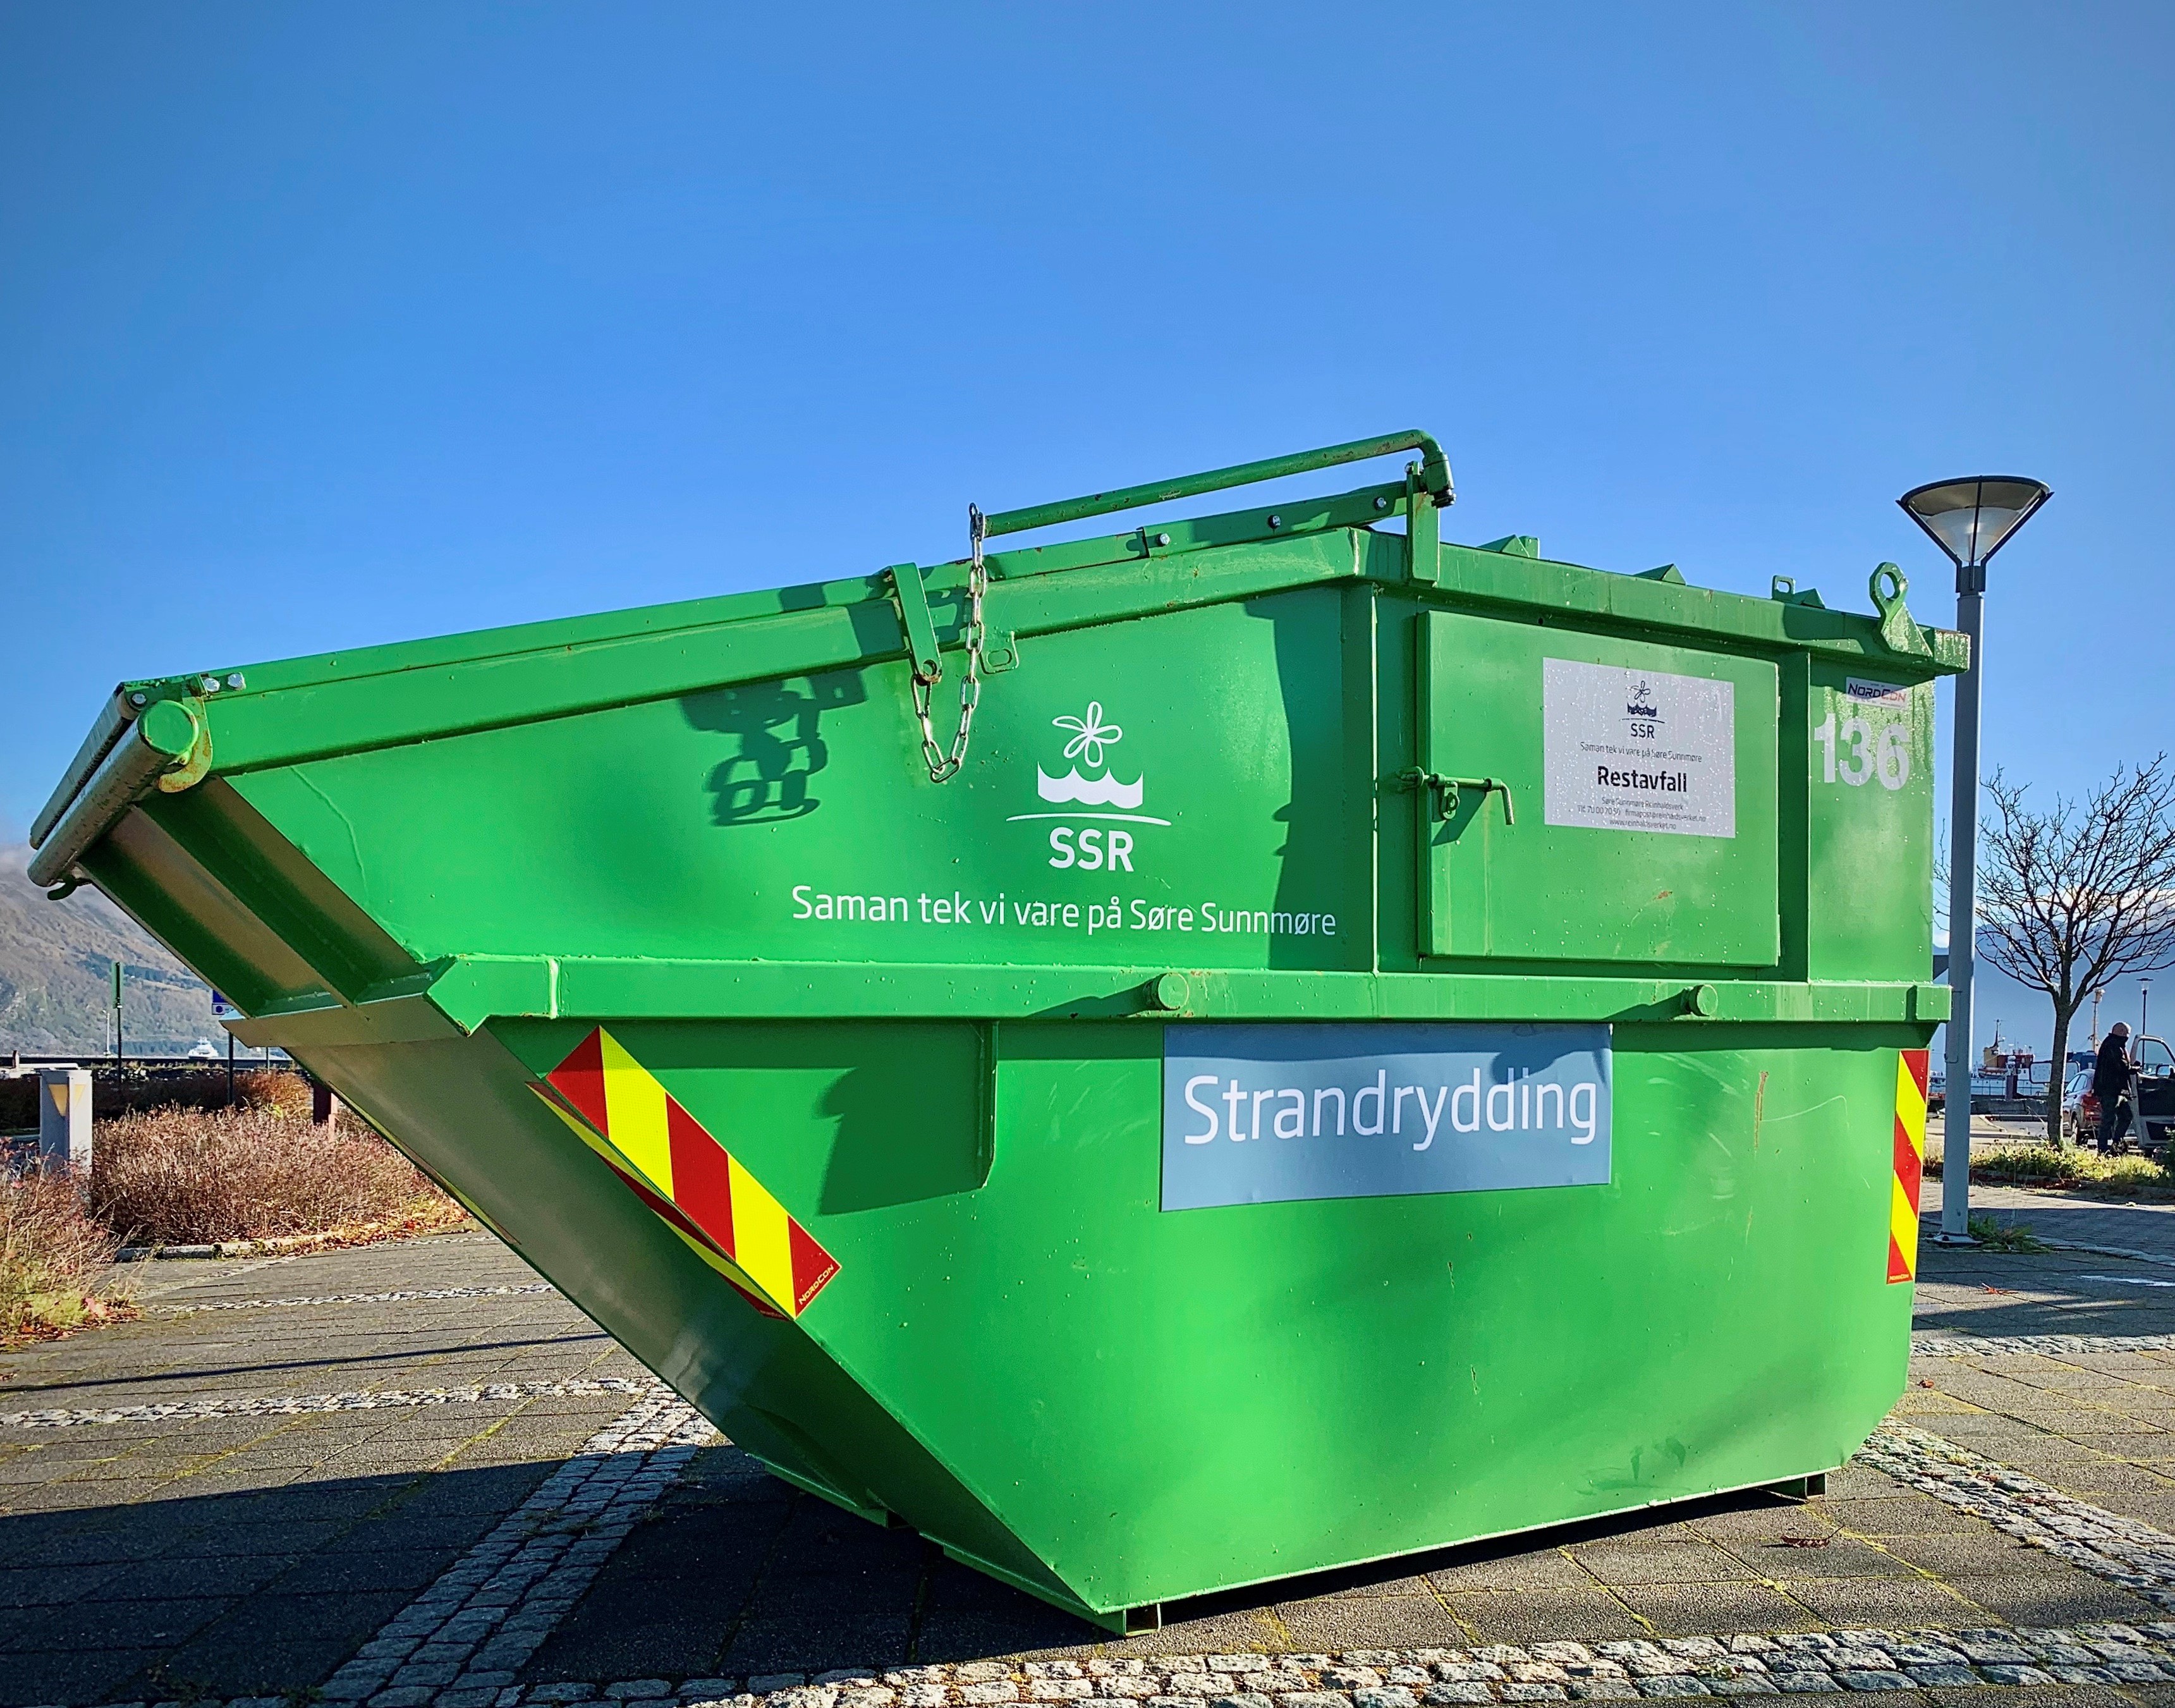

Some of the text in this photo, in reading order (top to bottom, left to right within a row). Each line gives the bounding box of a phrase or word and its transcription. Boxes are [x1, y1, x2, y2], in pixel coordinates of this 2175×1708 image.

[1580, 741, 1702, 762] Saman tek vi vare på Søre Sunnmøre
[1630, 723, 1655, 739] SSR
[1814, 713, 1910, 790] 136
[1598, 766, 1688, 793] Restavfall
[1048, 827, 1135, 872] SSR
[792, 886, 1336, 936] Saman tek vi vare på Søre Sunnmøre
[1184, 1067, 1597, 1151] Strandrydding
